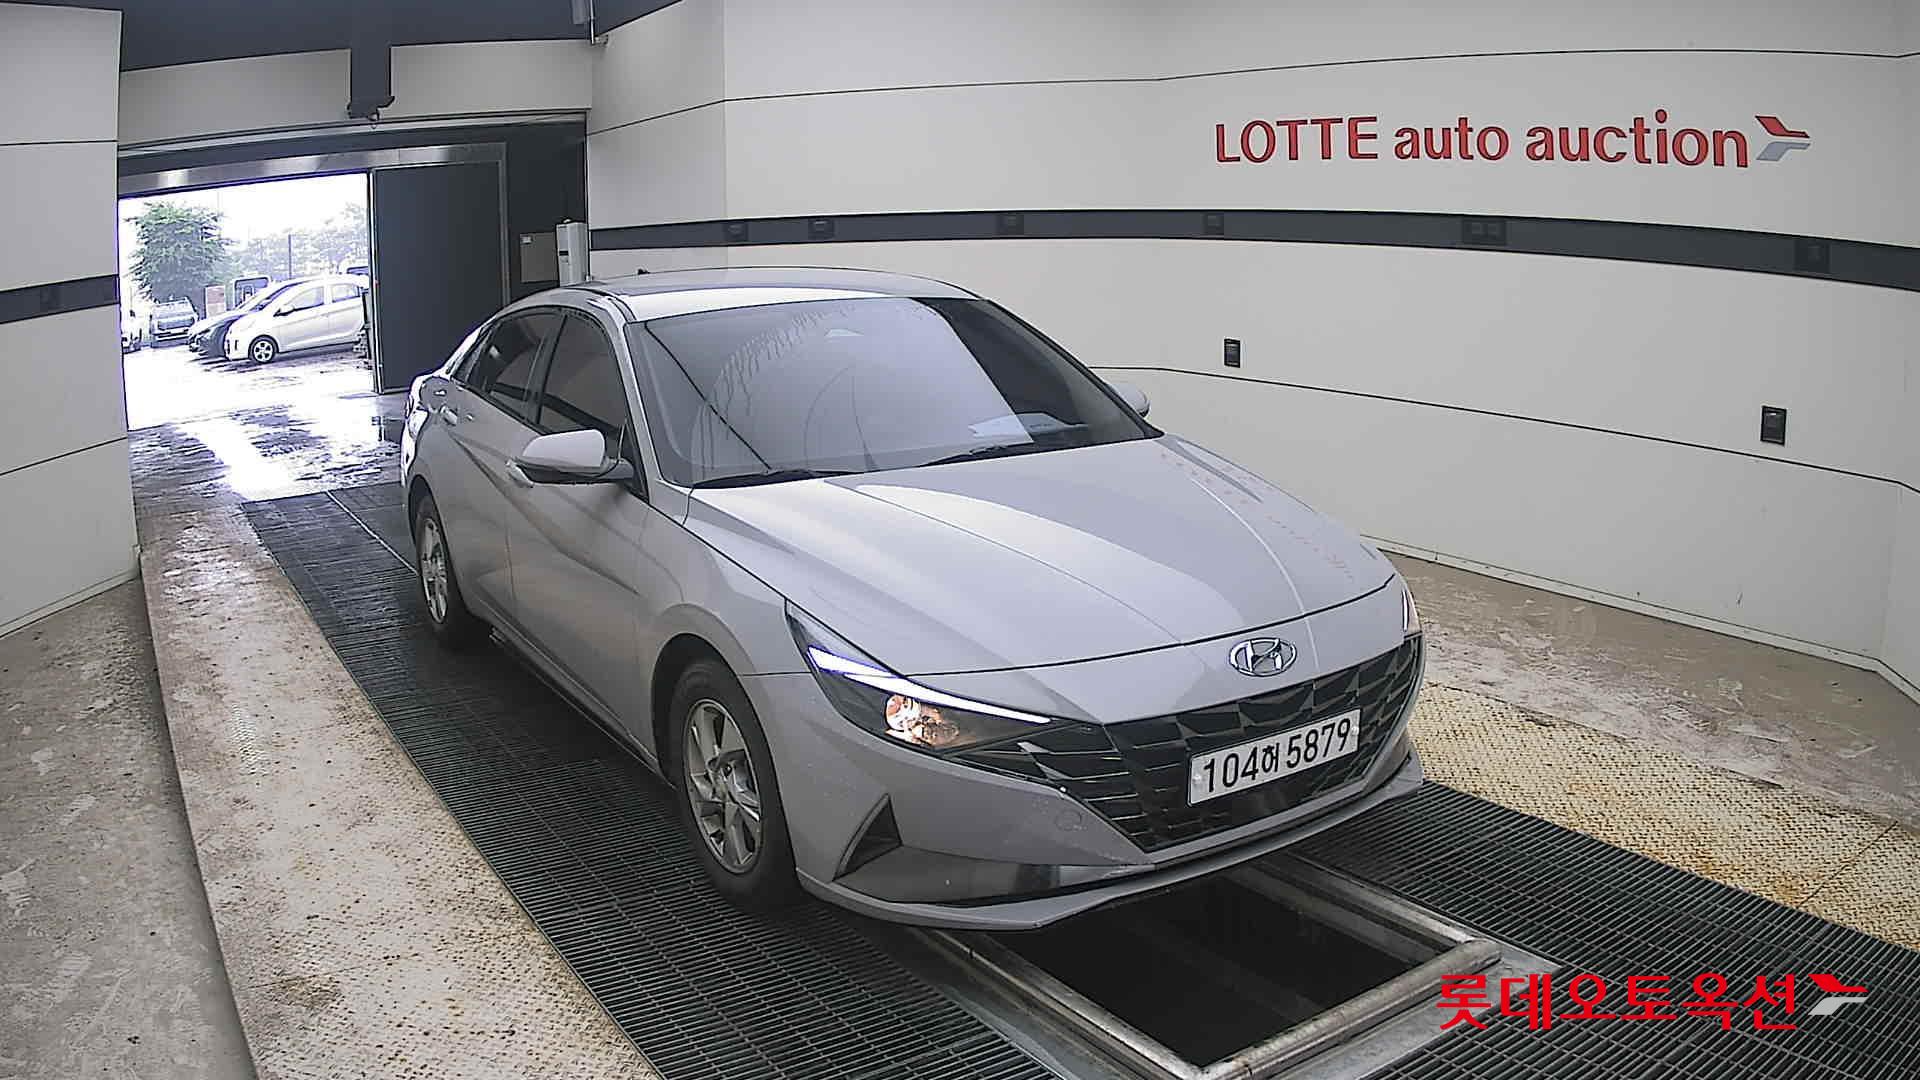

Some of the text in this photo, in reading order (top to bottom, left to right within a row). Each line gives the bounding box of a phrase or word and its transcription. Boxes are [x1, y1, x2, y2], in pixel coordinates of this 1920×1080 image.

[1215, 108, 1749, 168] LOTTE auto auction
[1203, 717, 1352, 793] 104허 5879
